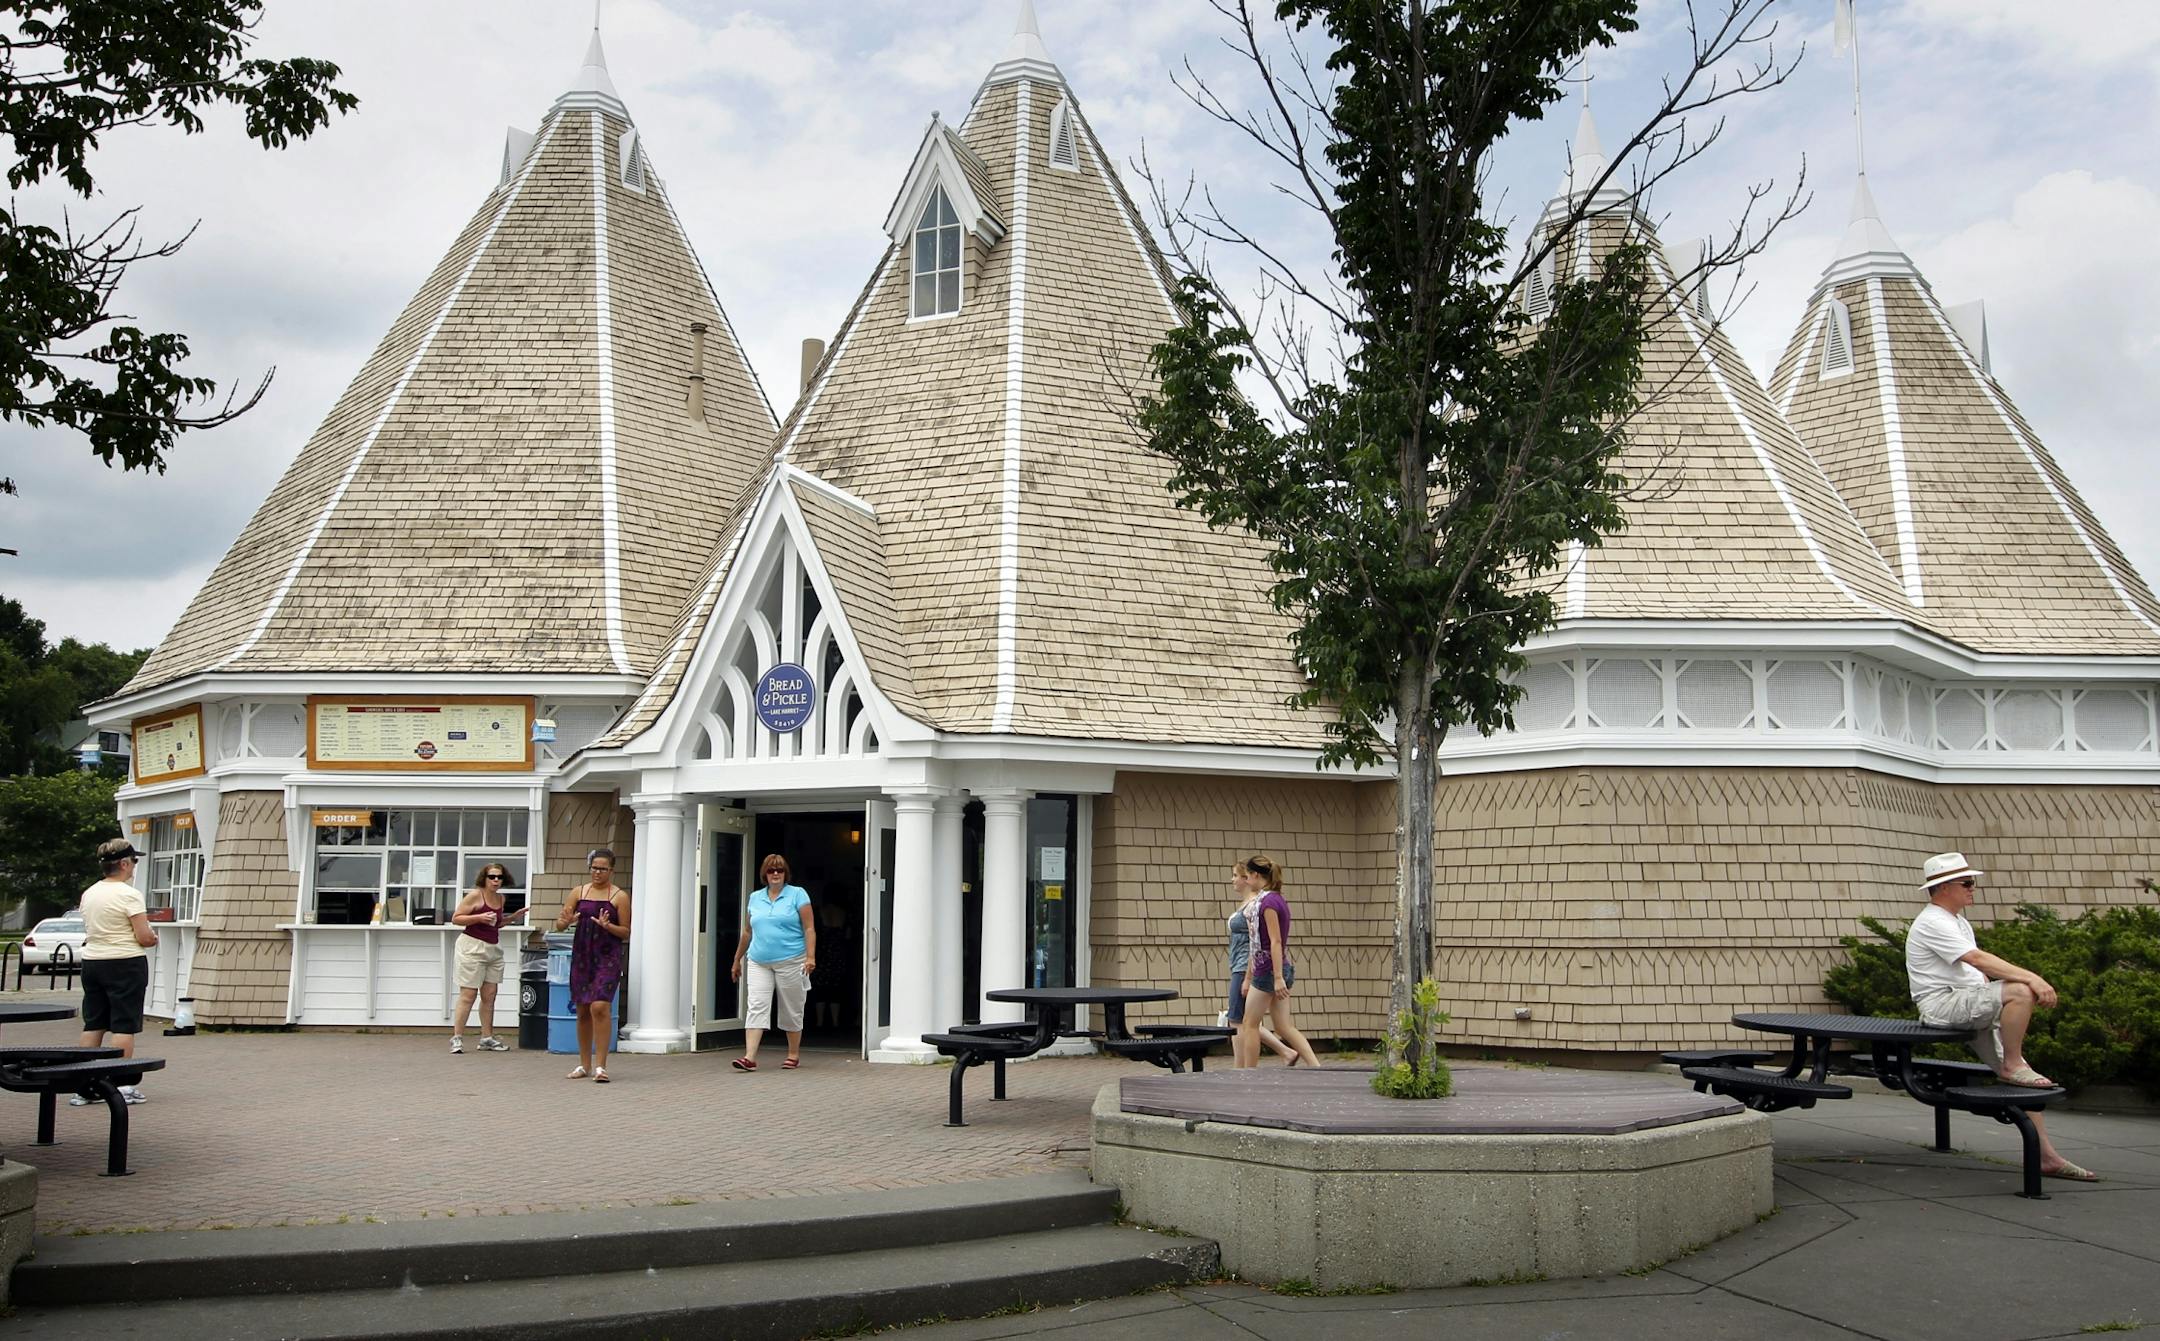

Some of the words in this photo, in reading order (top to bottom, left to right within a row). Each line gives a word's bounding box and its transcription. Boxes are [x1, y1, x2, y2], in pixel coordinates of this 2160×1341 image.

[769, 678, 803, 692] BREAD
[762, 693, 770, 706] &
[772, 691, 808, 706] PICKLE
[323, 815, 357, 823] ORDER
